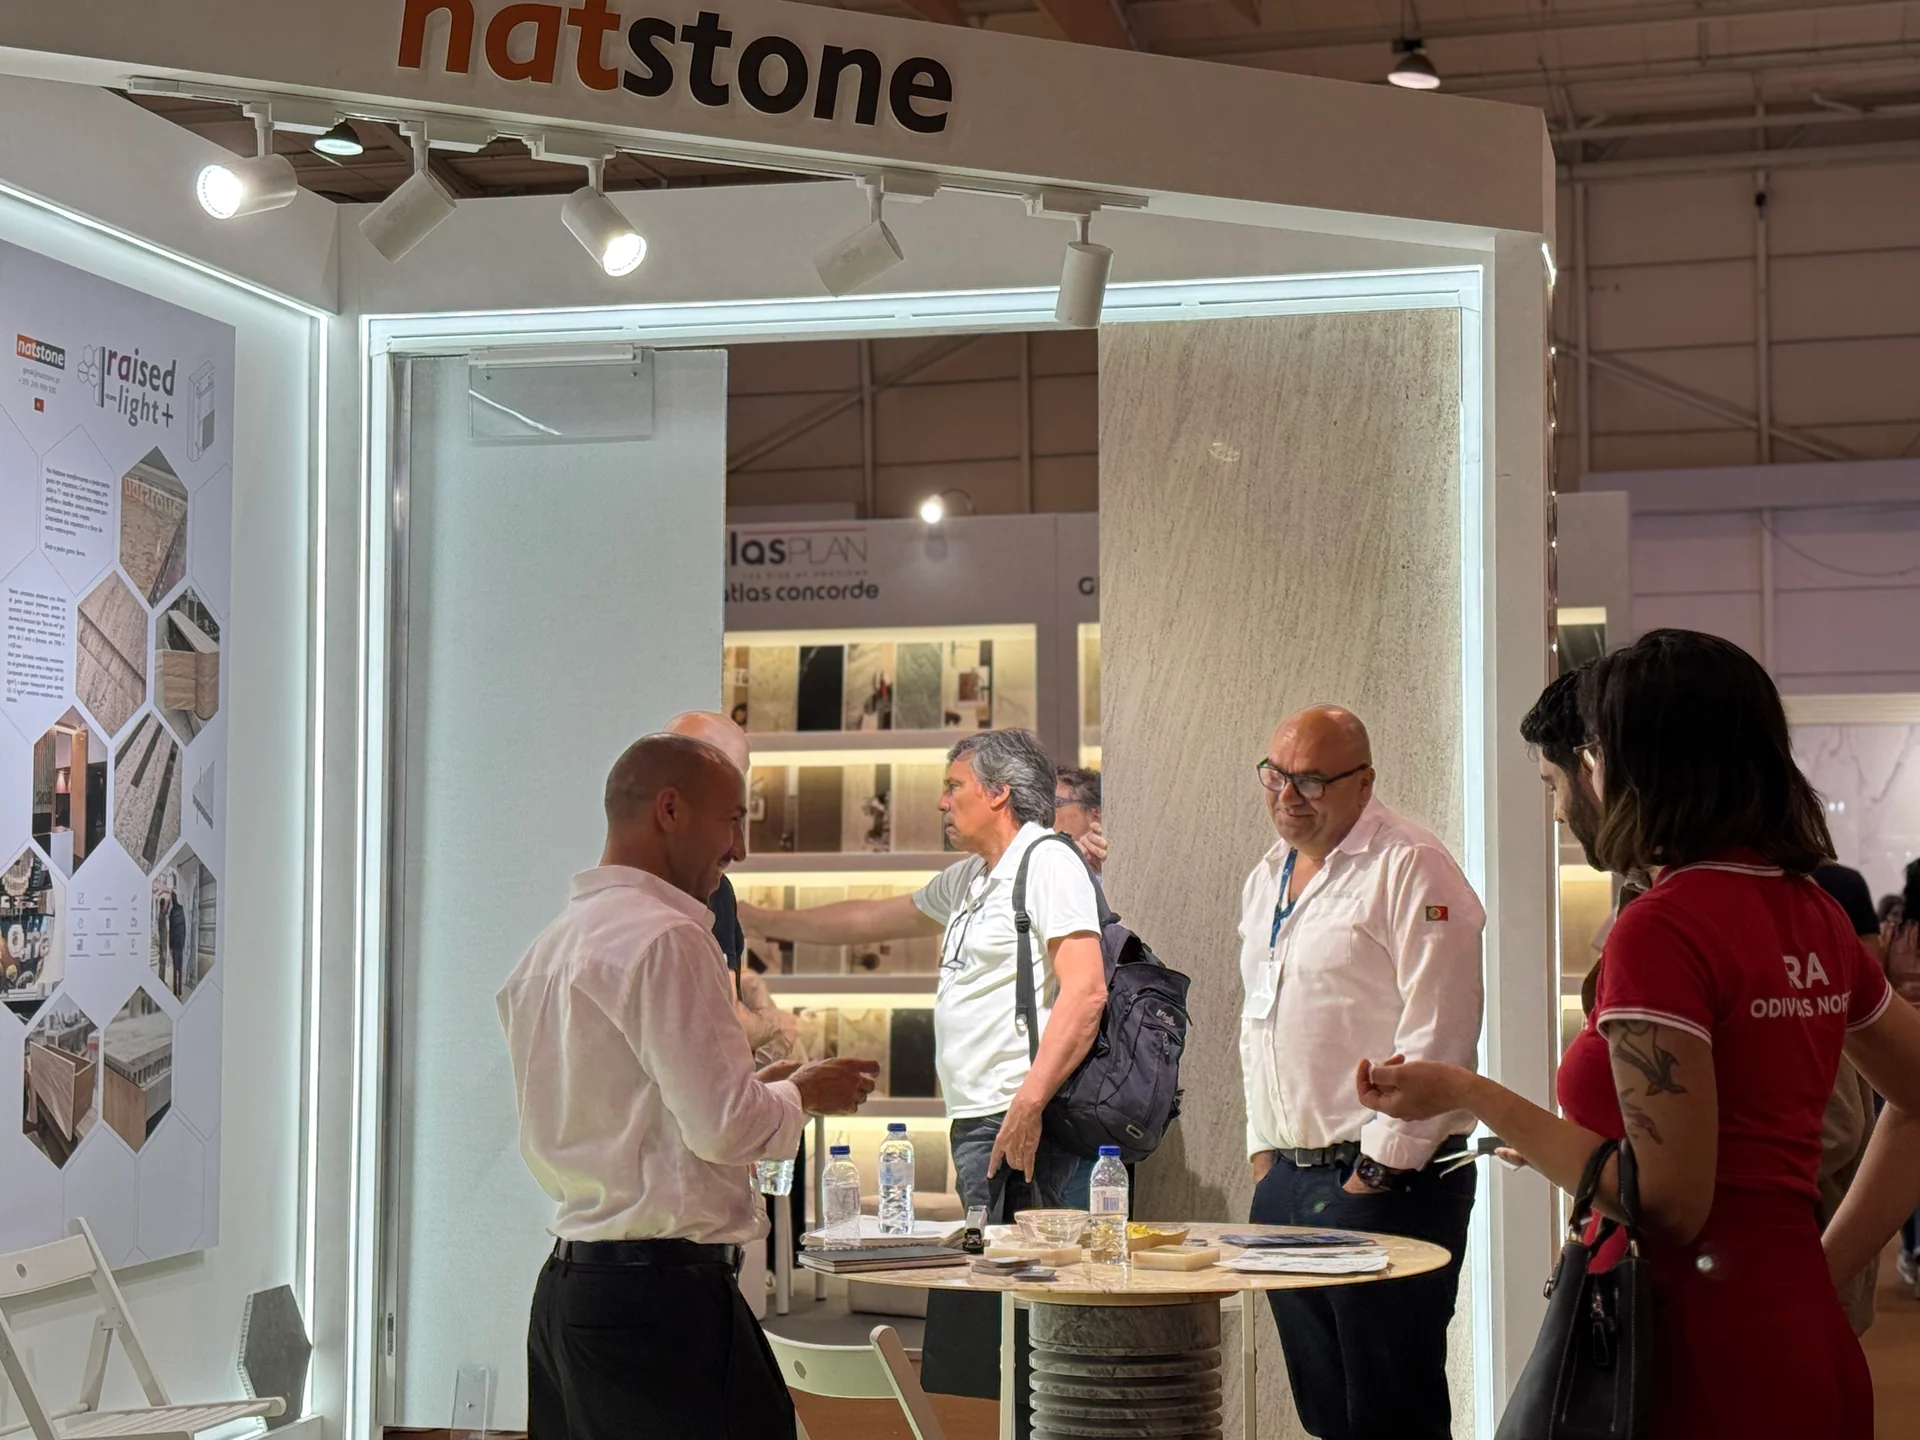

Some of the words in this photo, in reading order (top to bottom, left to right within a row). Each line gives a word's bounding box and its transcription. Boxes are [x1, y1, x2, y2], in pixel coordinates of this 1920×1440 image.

[397, 0, 953, 133] natstone
[18, 339, 65, 367] natstone
[106, 347, 177, 397] raised
[776, 579, 880, 602] concorde
